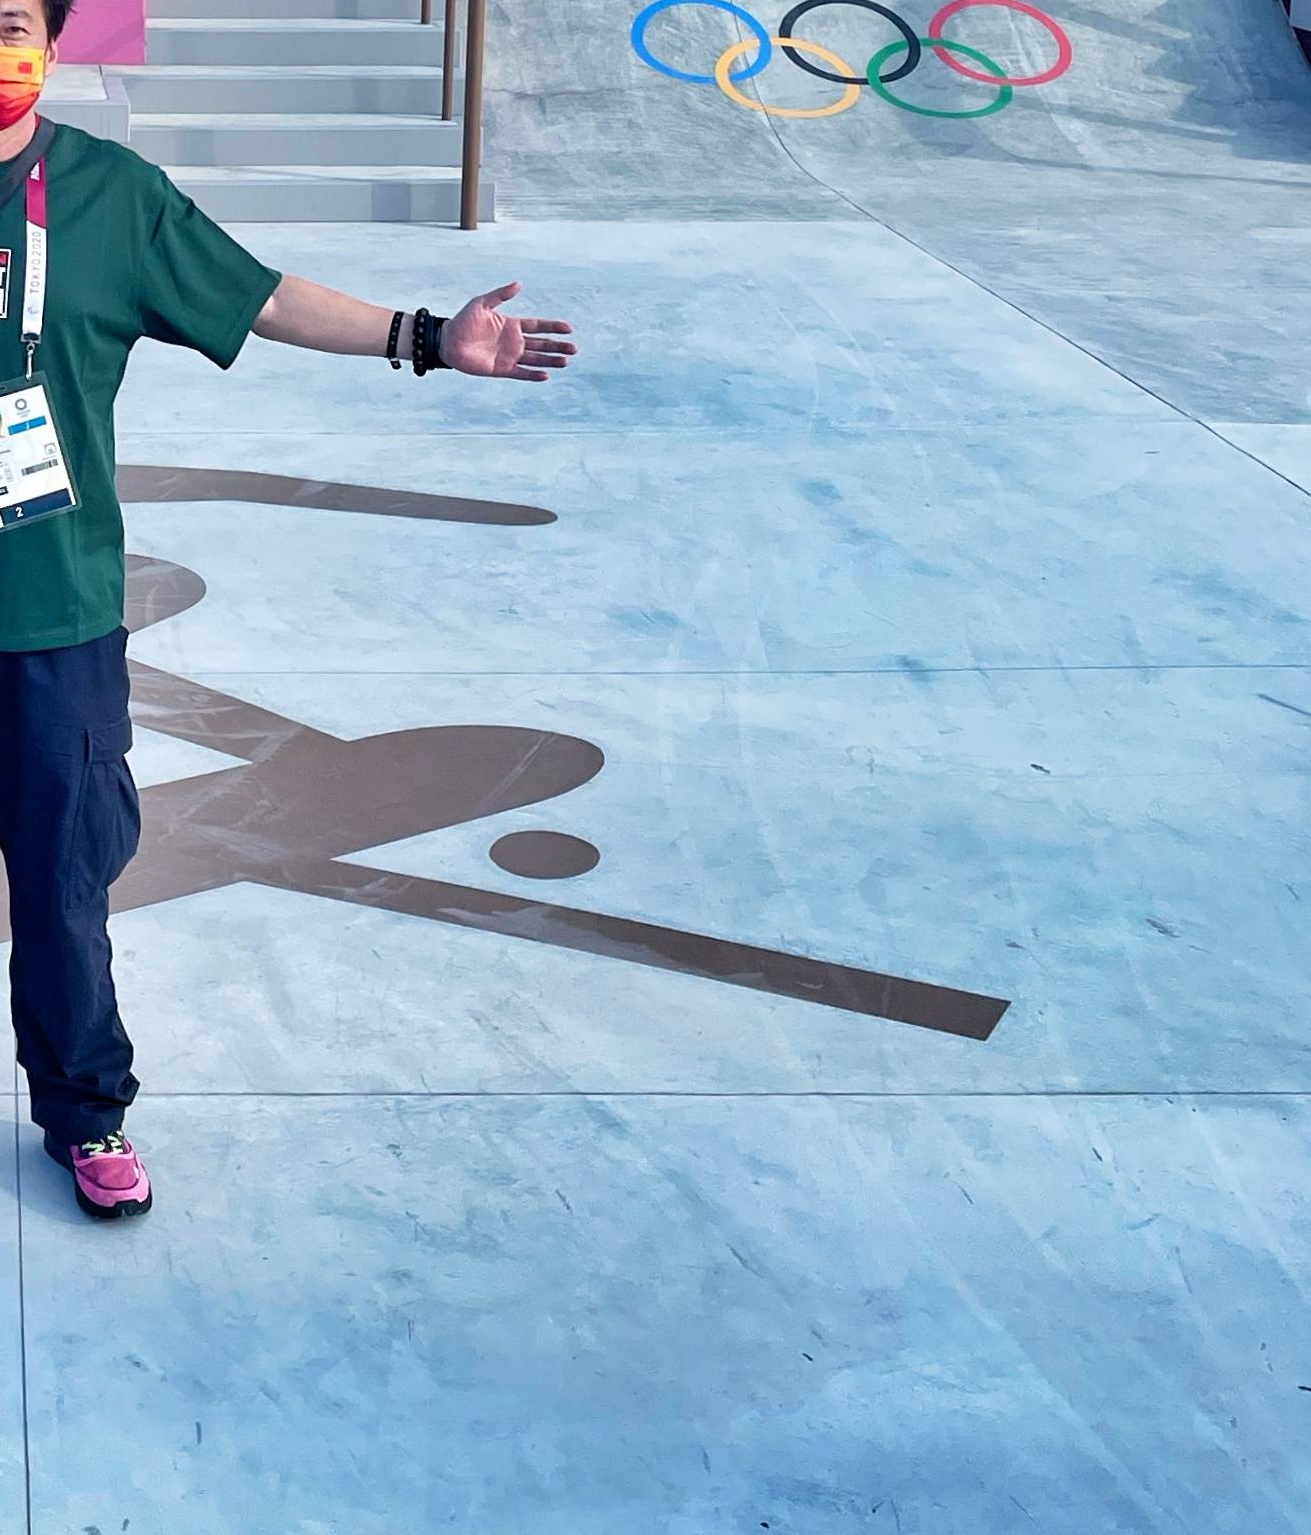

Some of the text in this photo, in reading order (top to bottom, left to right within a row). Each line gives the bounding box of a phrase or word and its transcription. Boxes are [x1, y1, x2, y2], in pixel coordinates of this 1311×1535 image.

[30, 230, 42, 295] TOKYO 2020
[15, 506, 24, 518] 2
